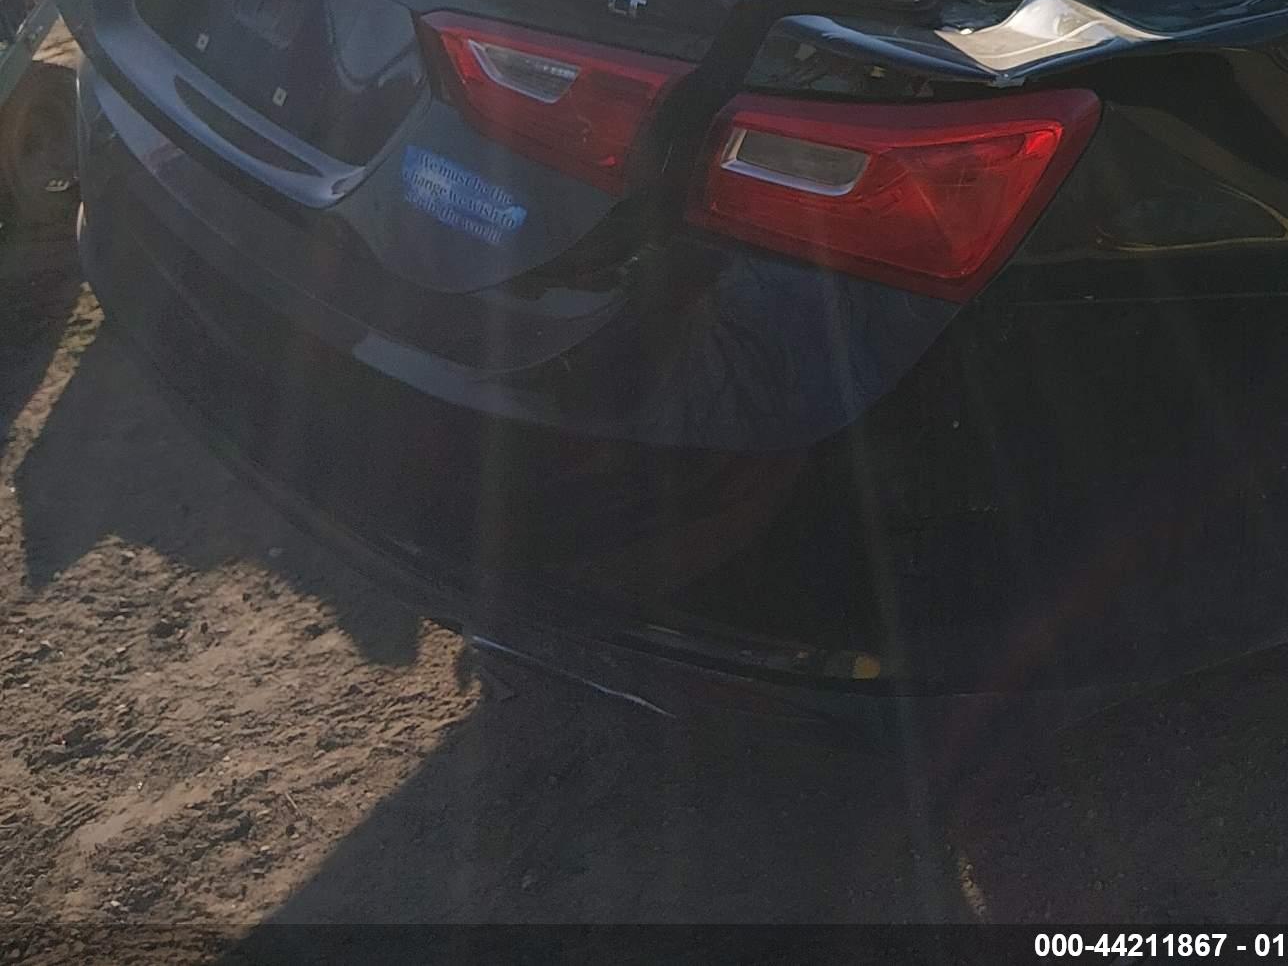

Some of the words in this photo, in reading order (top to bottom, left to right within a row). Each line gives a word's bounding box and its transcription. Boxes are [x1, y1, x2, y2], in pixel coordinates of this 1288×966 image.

[403, 169, 447, 197] change
[468, 198, 498, 221] wish
[417, 153, 437, 170] We
[438, 164, 471, 186] must
[472, 177, 488, 194] be
